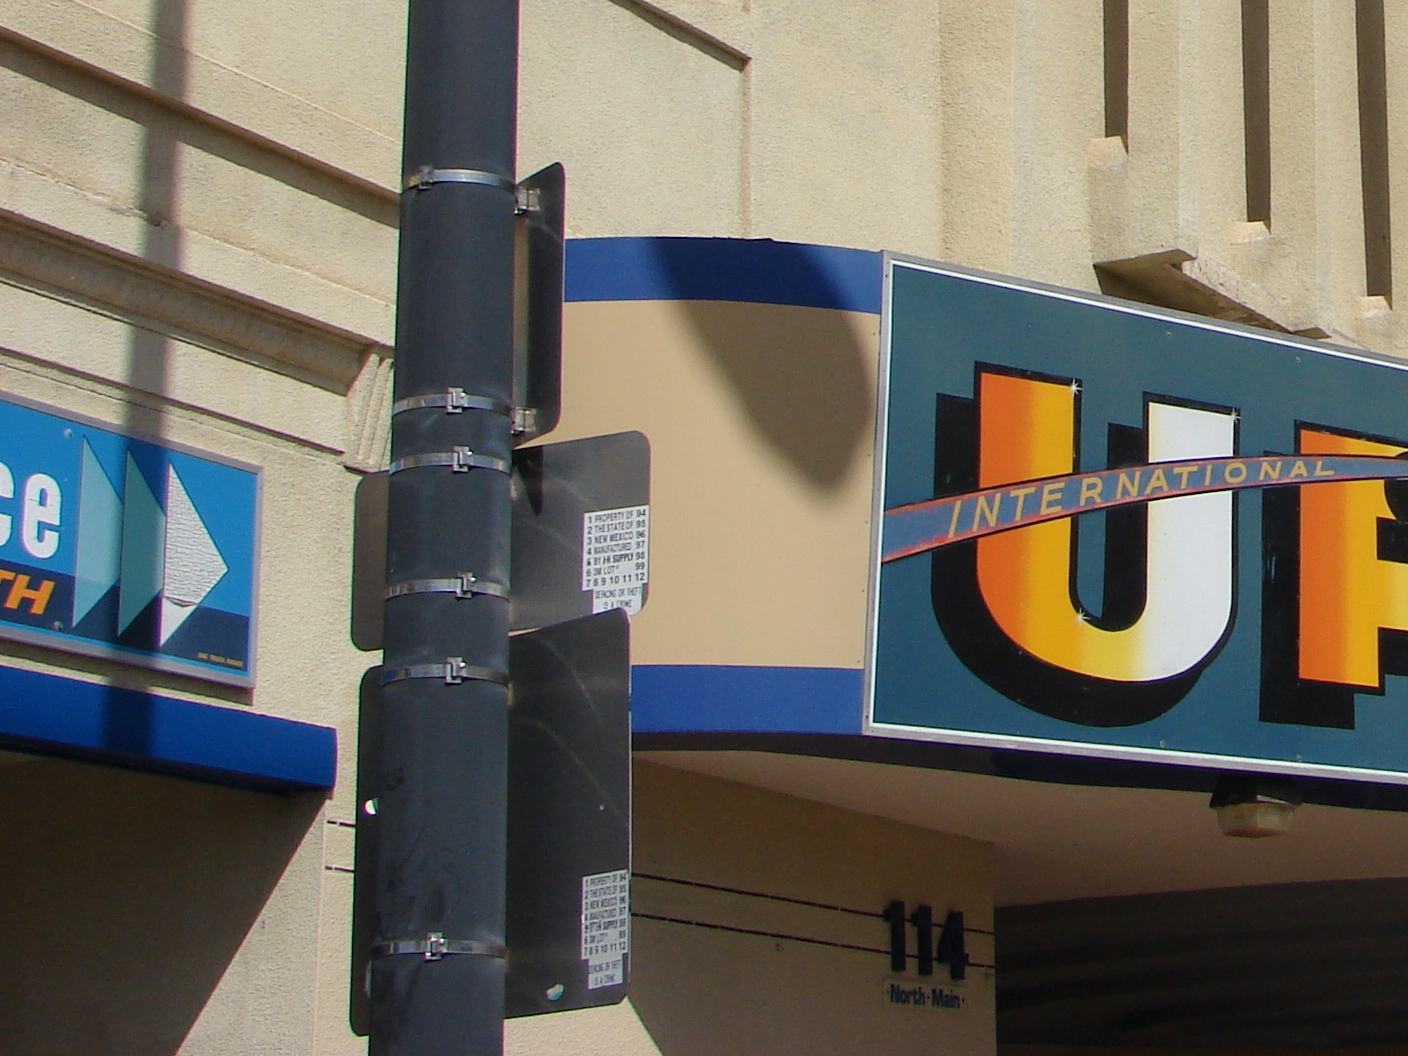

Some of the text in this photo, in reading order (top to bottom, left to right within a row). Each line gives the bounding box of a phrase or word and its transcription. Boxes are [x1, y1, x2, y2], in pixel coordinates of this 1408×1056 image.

[948, 460, 1335, 539] INTERNATIONAL
[636, 509, 646, 518] 94
[587, 527, 593, 535] 2
[587, 537, 592, 545] 3
[587, 547, 592, 555] 4
[635, 541, 645, 550] 97
[586, 569, 591, 577] 6
[635, 562, 645, 570] 99
[586, 579, 591, 587] 7
[601, 577, 607, 586] 9
[610, 576, 619, 584] 10
[623, 574, 632, 583] 11
[635, 573, 645, 581] 12
[884, 900, 969, 980] 114
[890, 983, 960, 1009] North Main
